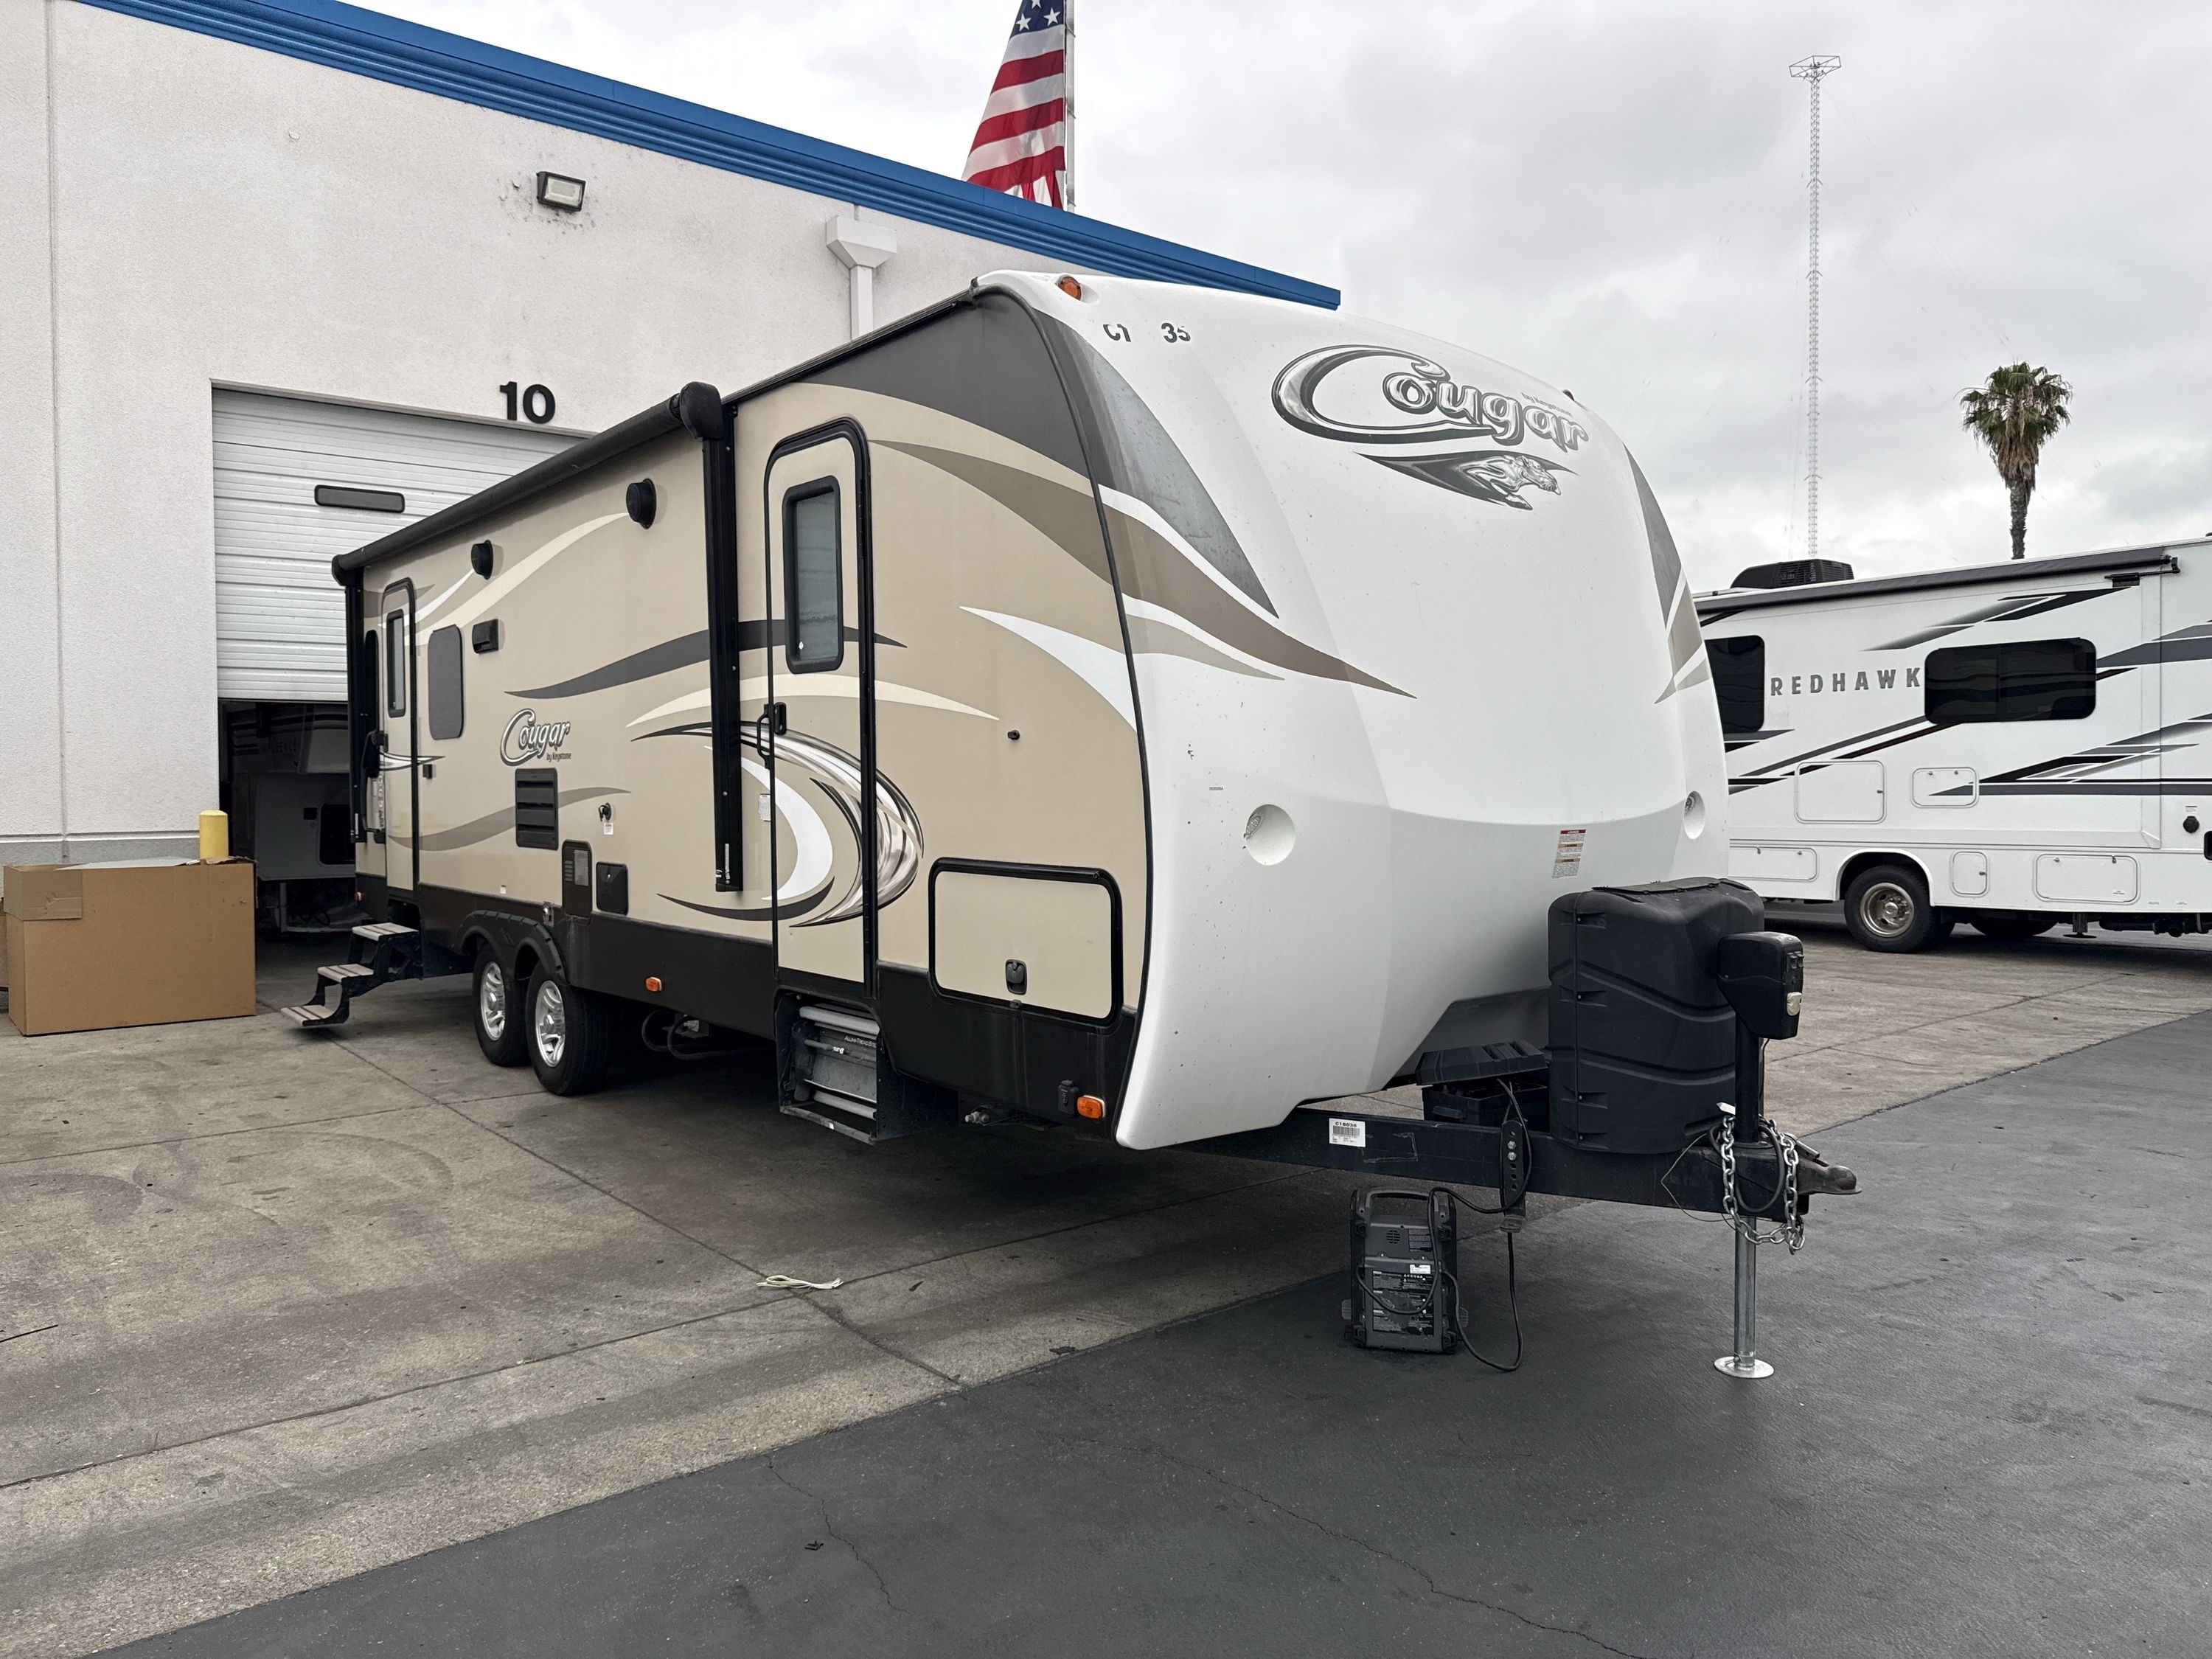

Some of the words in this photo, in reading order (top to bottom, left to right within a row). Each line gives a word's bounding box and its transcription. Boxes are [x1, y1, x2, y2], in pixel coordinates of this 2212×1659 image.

[499, 380, 556, 424] 10
[1271, 344, 1589, 453] Cougar
[1770, 667, 1920, 696] REDHAWK
[501, 708, 571, 766] Cougar
[546, 753, 552, 762] by
[552, 752, 571, 762] Keystone
